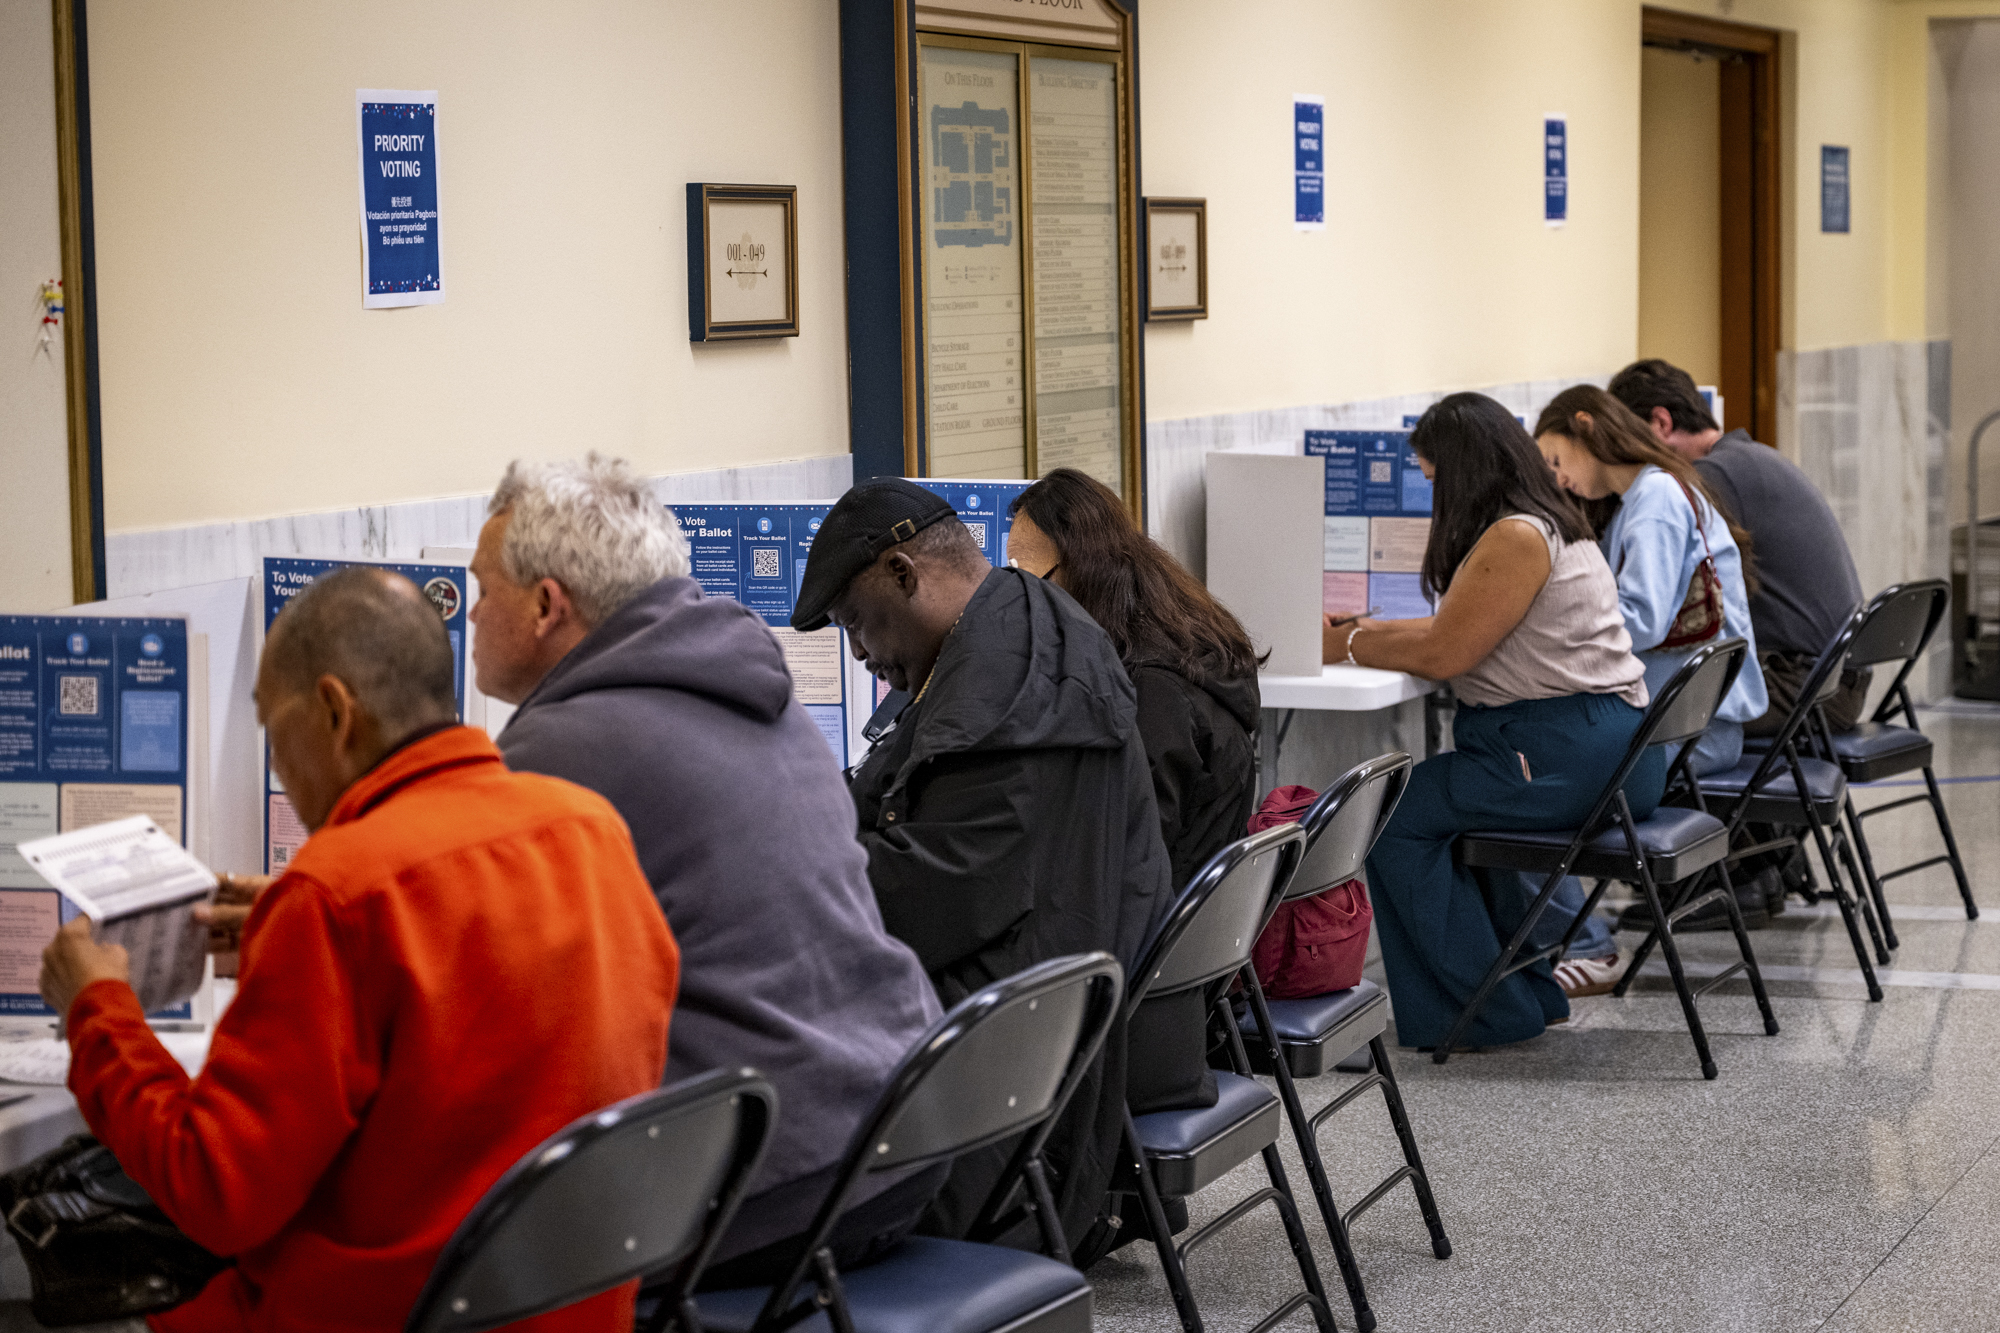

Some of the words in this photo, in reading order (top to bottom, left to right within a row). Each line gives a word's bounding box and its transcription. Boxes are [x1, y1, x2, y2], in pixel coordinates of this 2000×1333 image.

[374, 135, 424, 152] PRIORITY
[380, 160, 420, 178] VOTING
[367, 211, 390, 220] Votación
[391, 210, 414, 220] prioritaria
[415, 210, 436, 220] Pagboto
[380, 225, 391, 234] ayon
[399, 223, 426, 233] prayoridad
[727, 244, 741, 261] 001
[750, 244, 765, 261] 049
[675, 517, 682, 526] o
[685, 517, 706, 526] Vote
[699, 528, 732, 537] Ballot
[272, 572, 286, 582] To
[288, 572, 313, 584] Vote
[0, 646, 30, 659] allot
